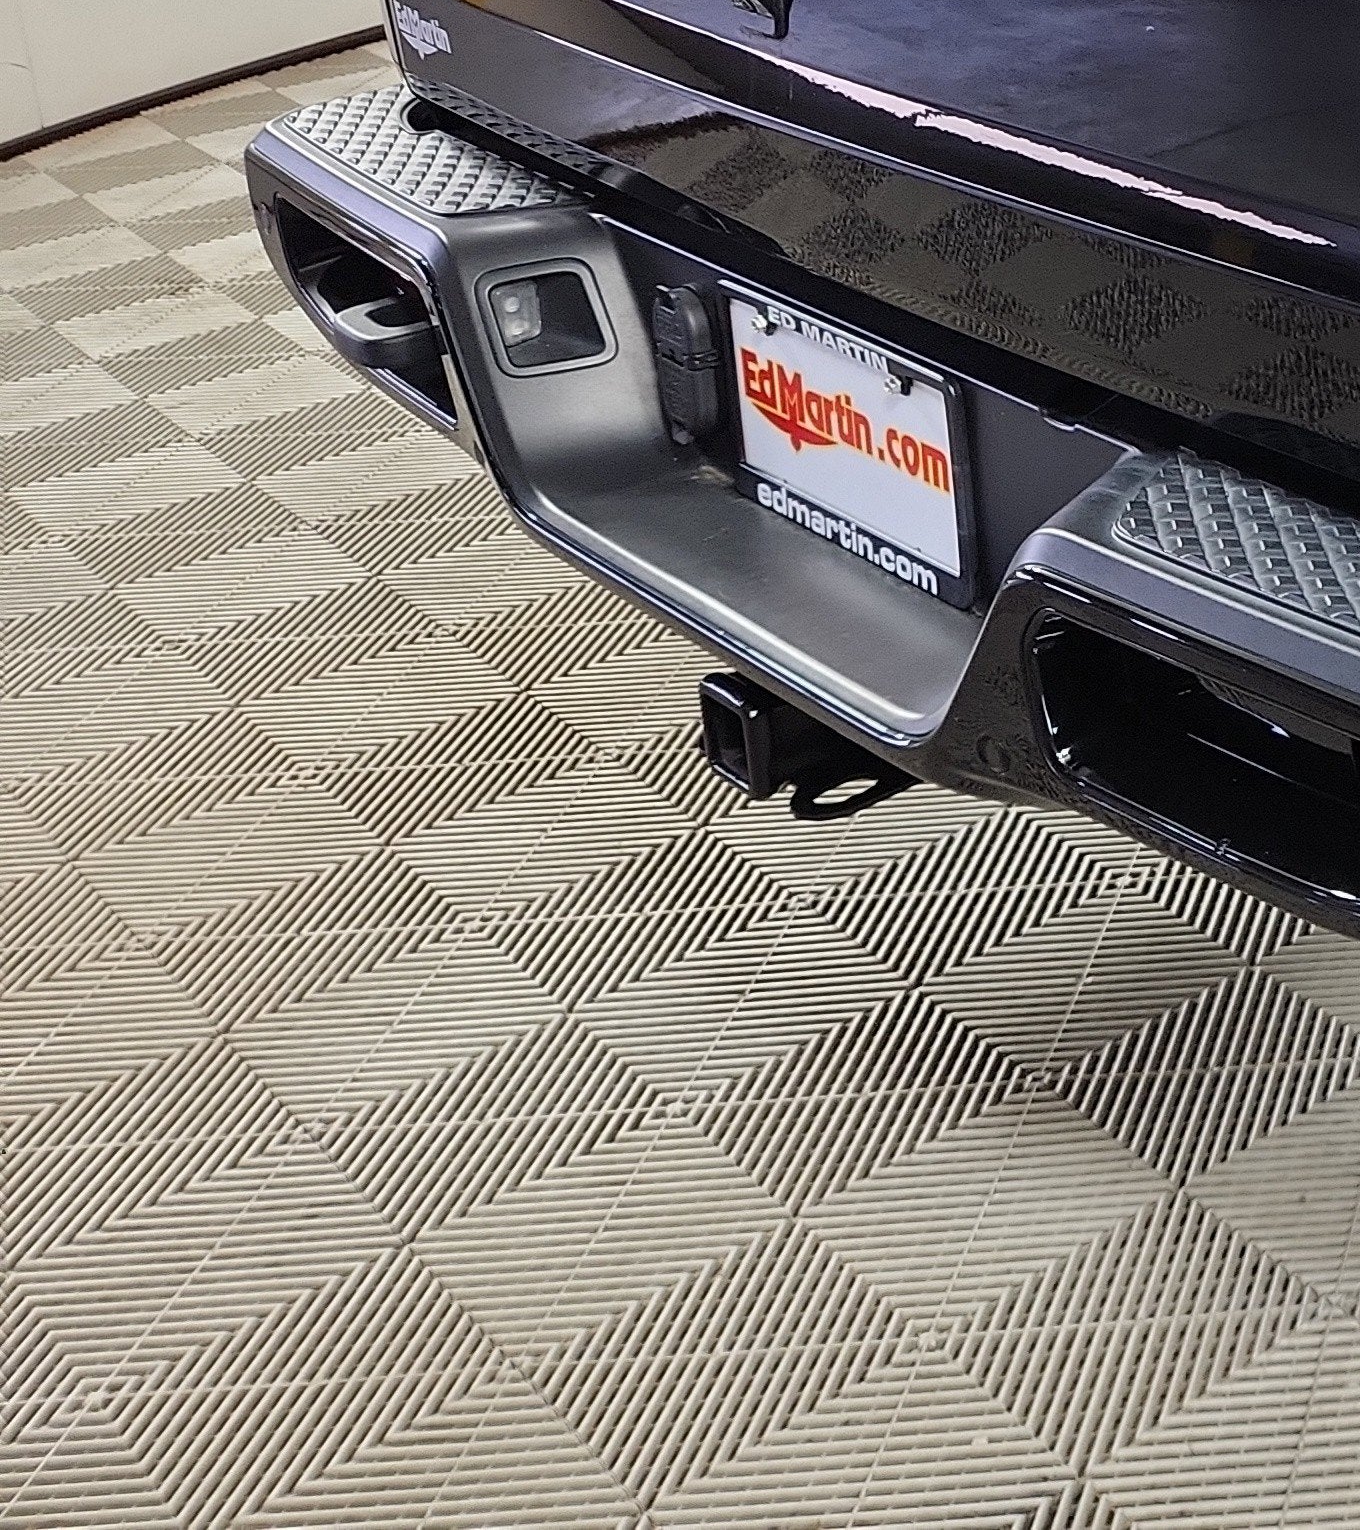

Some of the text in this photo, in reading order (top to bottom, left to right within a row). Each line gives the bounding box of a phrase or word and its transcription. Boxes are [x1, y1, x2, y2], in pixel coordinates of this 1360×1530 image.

[766, 305, 890, 372] ED MARTIN
[756, 481, 938, 596] edmartin.com
